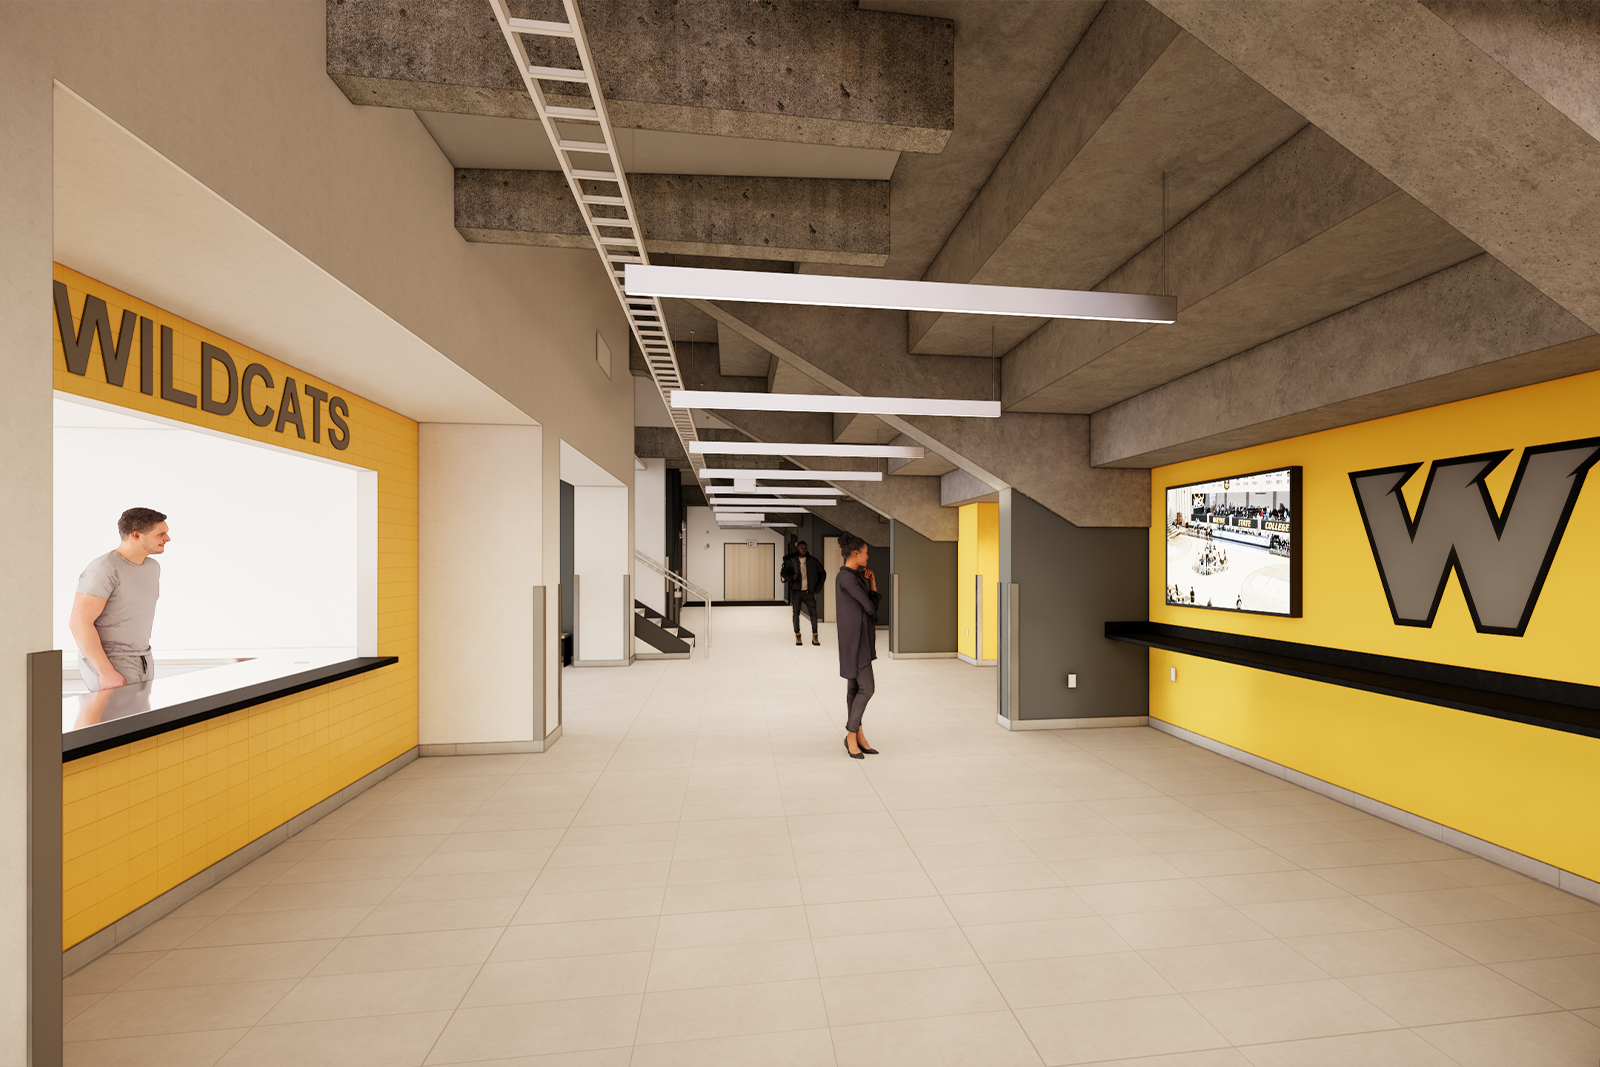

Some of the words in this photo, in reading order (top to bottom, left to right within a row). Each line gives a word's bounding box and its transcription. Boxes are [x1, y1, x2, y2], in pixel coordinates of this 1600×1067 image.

[53, 280, 350, 451] WILDCATS
[1237, 519, 1251, 527] STATE
[1264, 521, 1290, 532] COLLEGE
[1348, 436, 1600, 637] W
